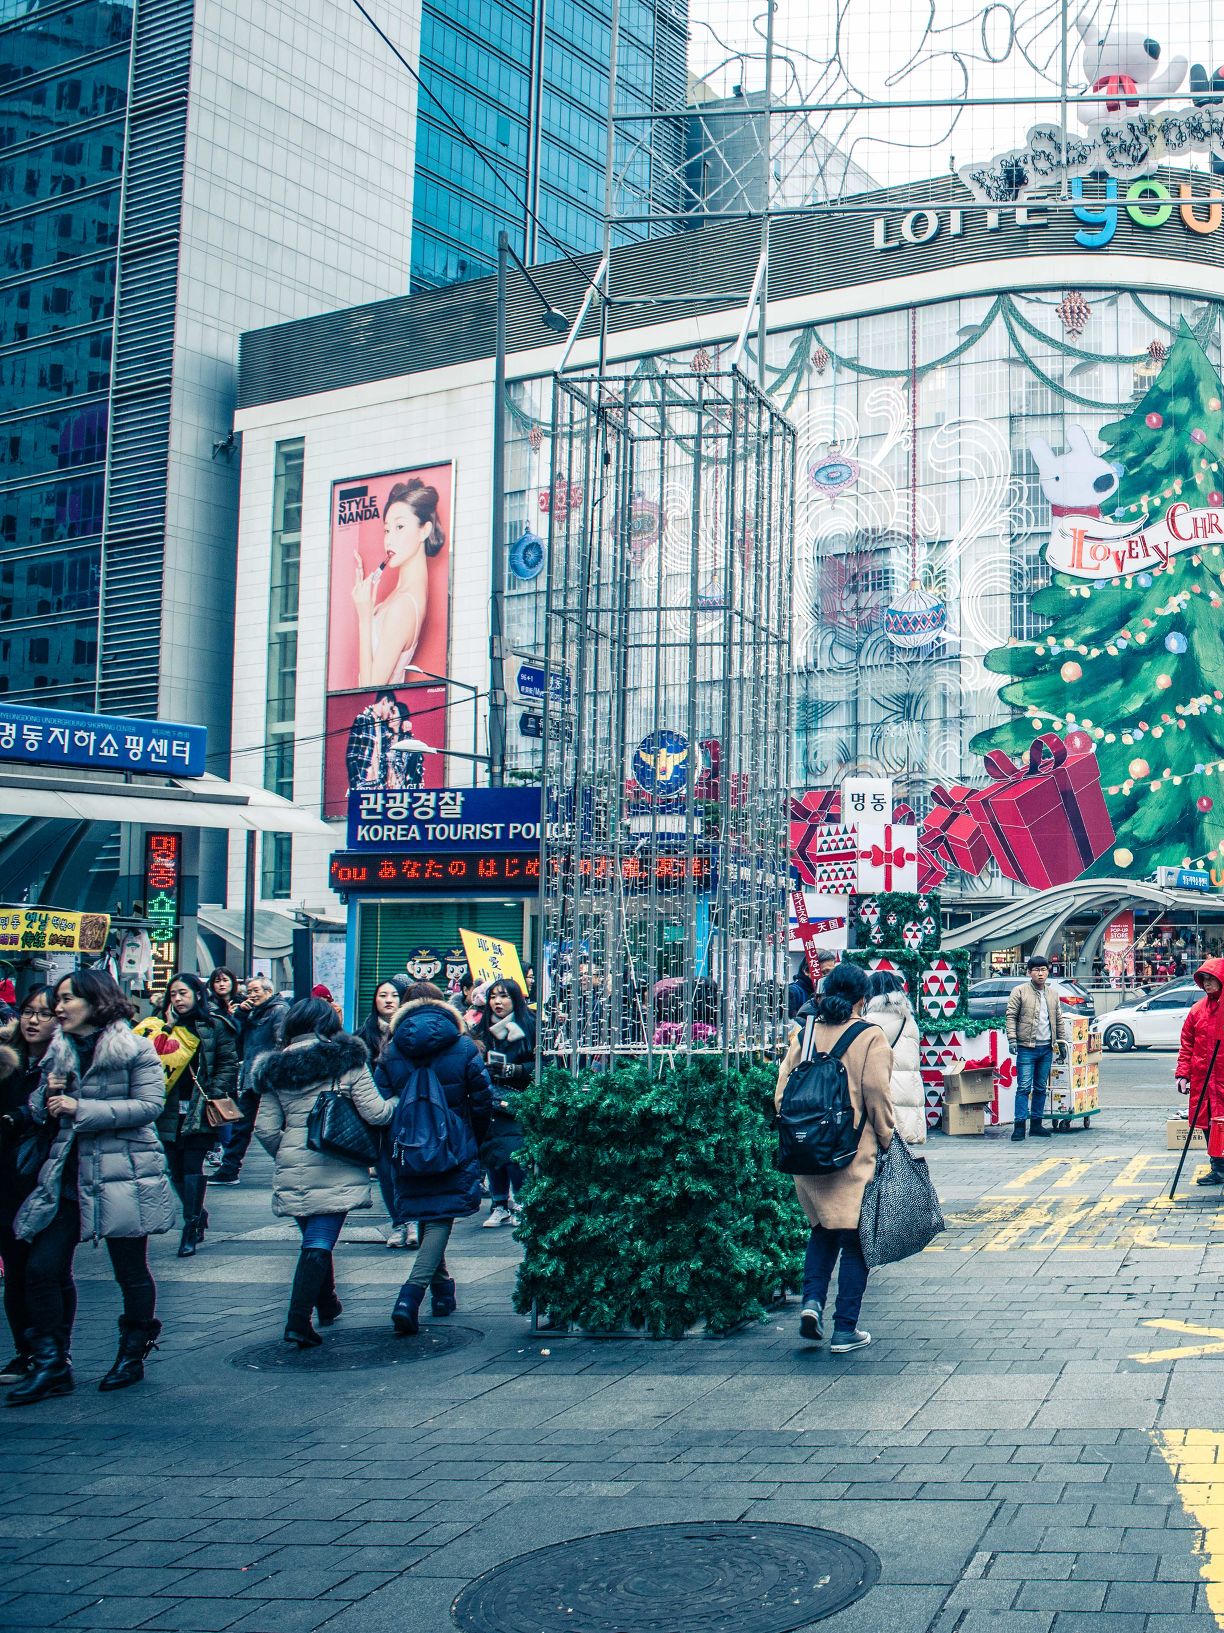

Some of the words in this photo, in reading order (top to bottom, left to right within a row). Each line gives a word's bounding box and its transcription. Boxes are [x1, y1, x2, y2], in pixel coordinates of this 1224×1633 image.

[873, 194, 1050, 251] LOTTE
[338, 496, 377, 513] STYLE
[338, 508, 380, 525] NANDA
[0, 722, 191, 766] 명동지하쇼핑센터
[359, 790, 465, 820] 관광경찰
[851, 793, 887, 811] 명동
[356, 824, 421, 842] KOREA
[424, 823, 504, 841] TOURIST
